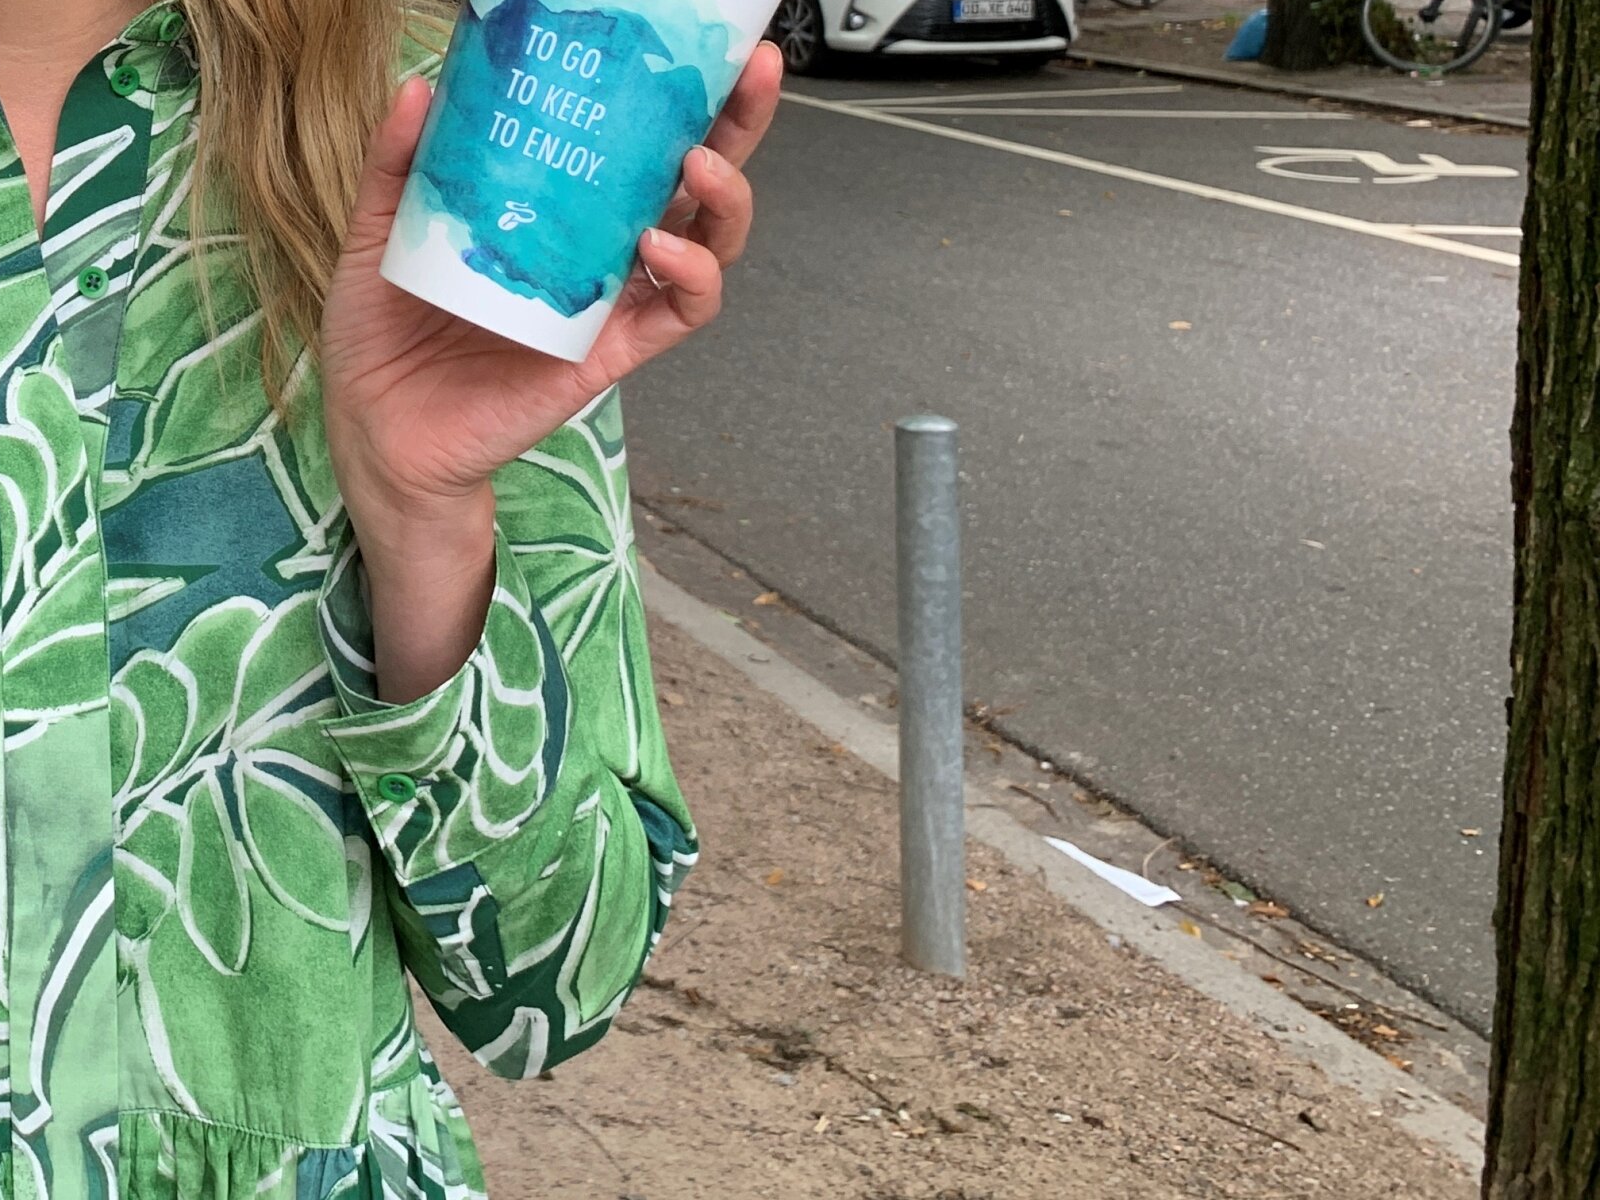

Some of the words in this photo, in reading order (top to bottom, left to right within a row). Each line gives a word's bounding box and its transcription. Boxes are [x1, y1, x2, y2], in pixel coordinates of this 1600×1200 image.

[525, 24, 558, 62] TO
[561, 40, 601, 84] GO.
[506, 68, 539, 106] TO
[540, 83, 606, 136] KEEP.
[488, 110, 520, 148] TO
[522, 126, 606, 186] ENJOY.
